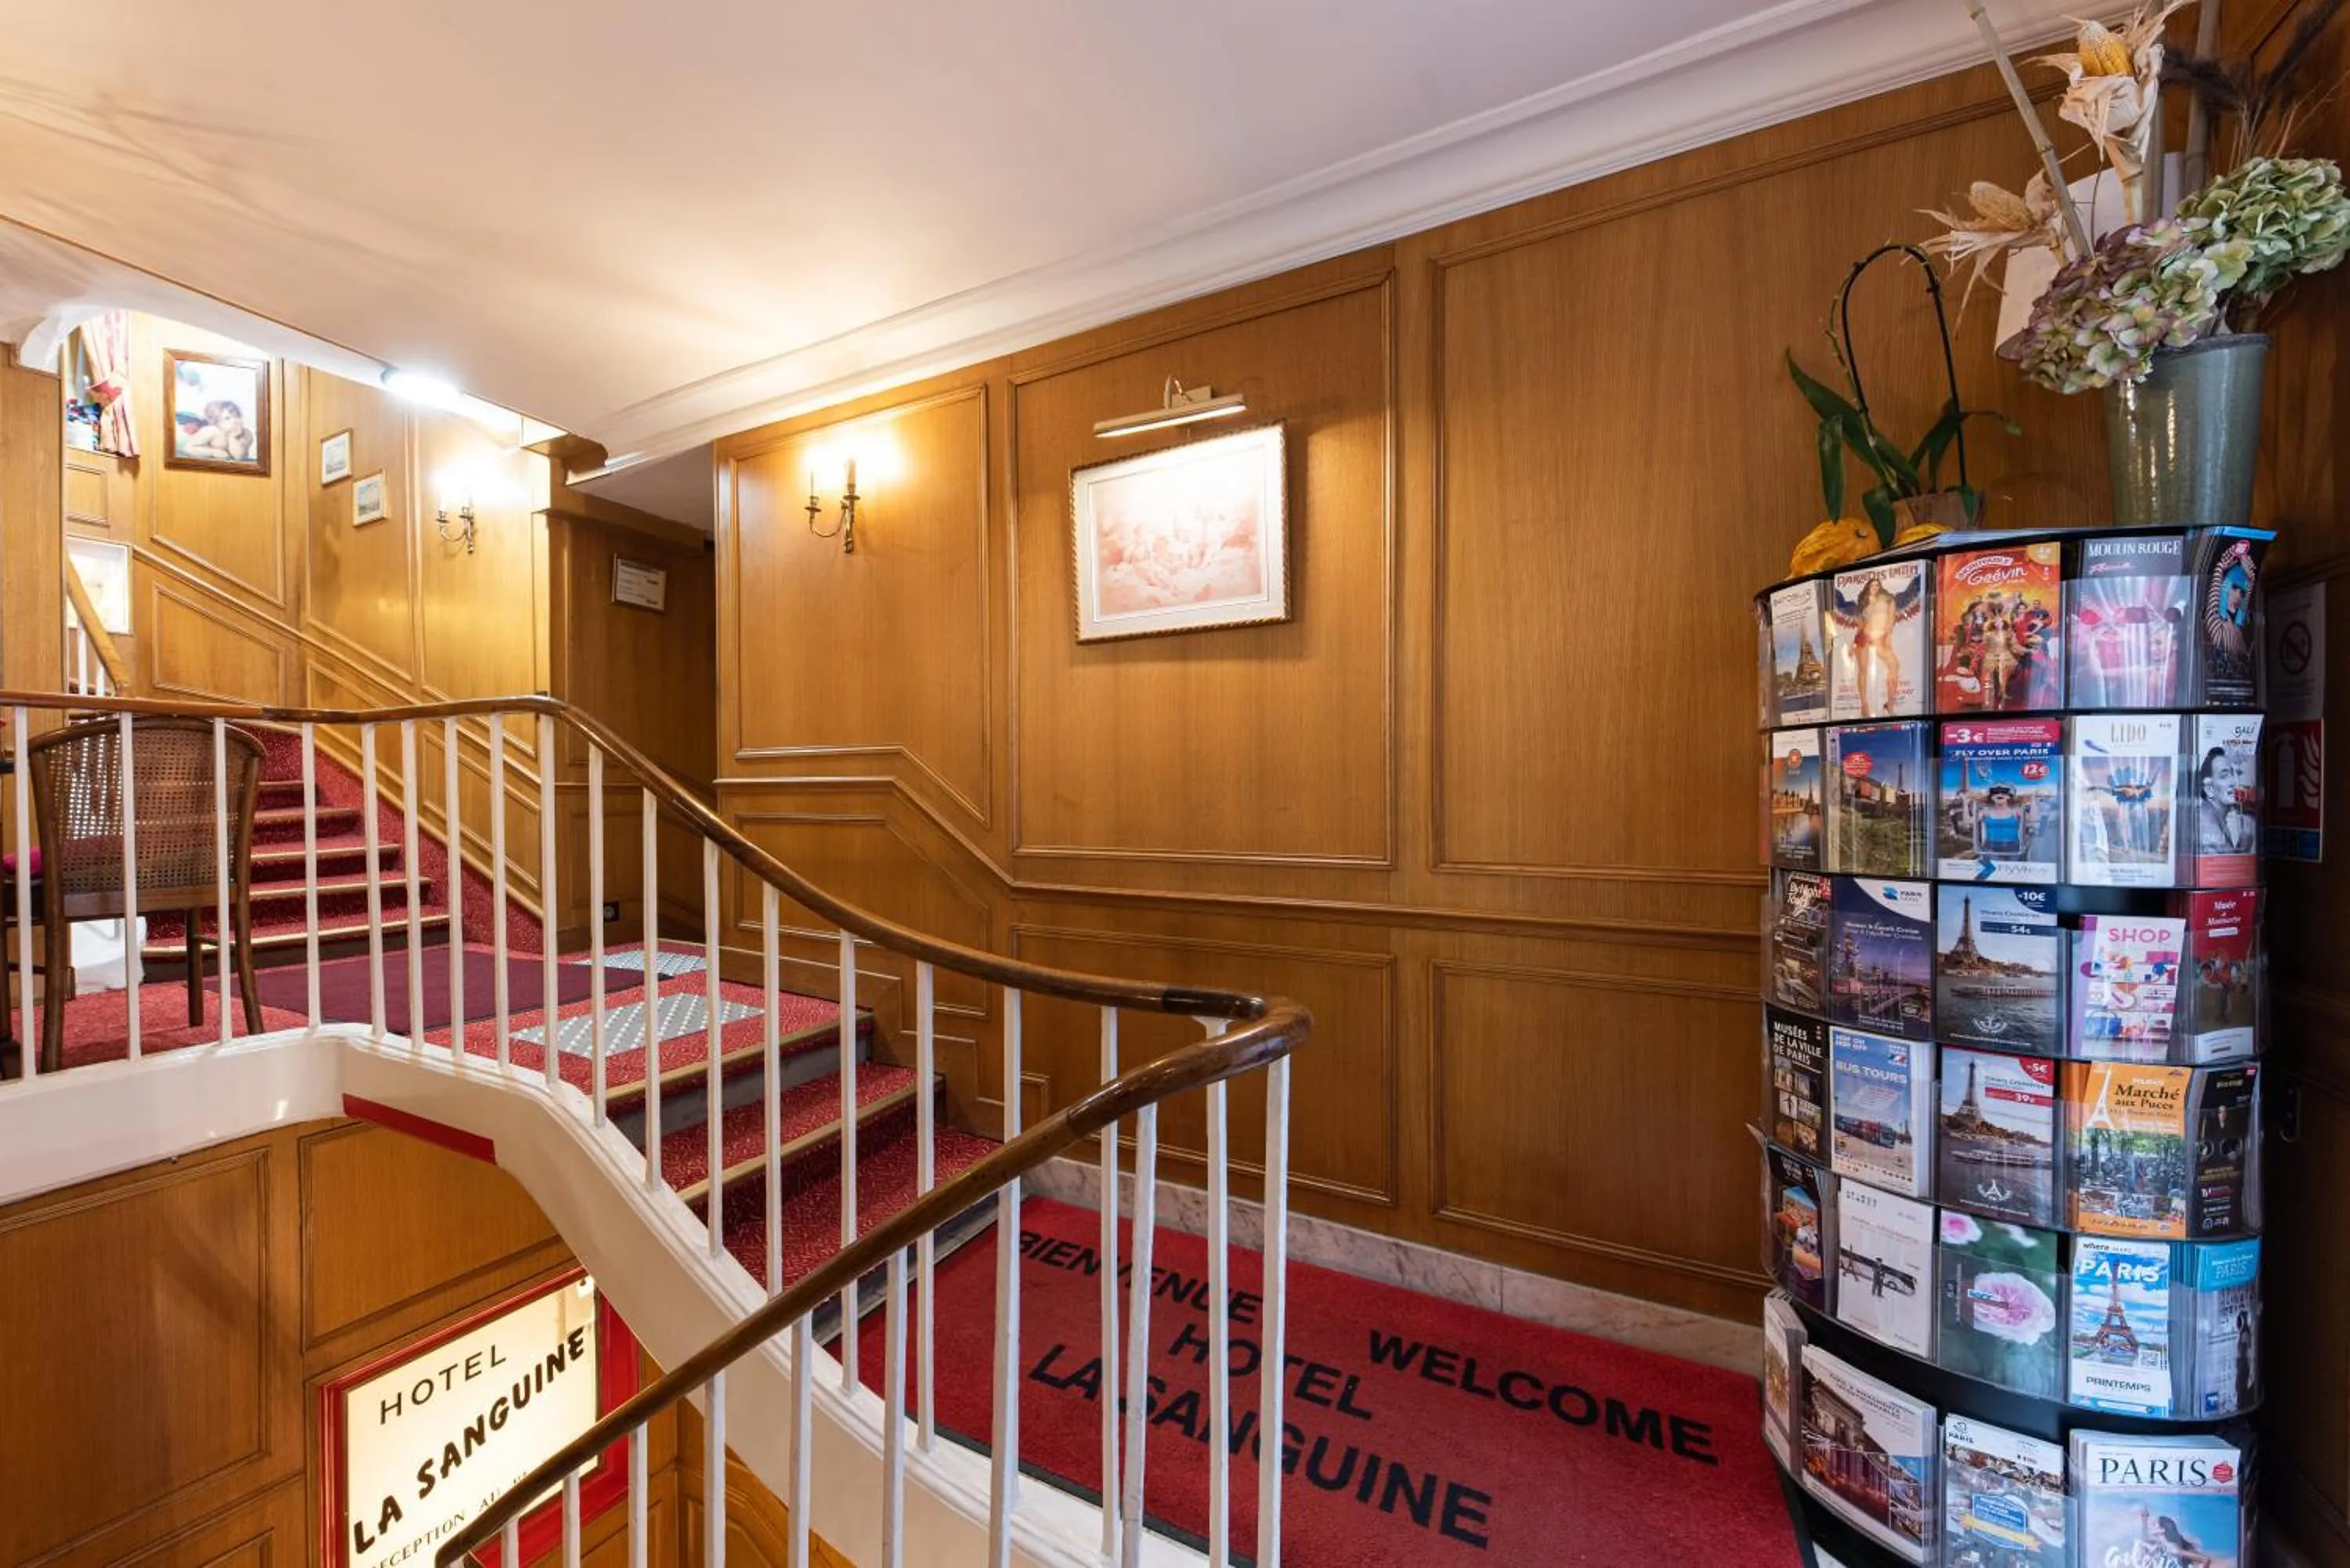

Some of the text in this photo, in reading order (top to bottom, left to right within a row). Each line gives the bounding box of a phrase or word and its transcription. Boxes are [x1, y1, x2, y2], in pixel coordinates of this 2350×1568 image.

[2088, 540, 2182, 558] MOULIN ROUGE
[2017, 891, 2046, 901] -10€
[2108, 927, 2171, 943] SHOP
[1773, 1021, 1808, 1041] MUSÉES
[1773, 1031, 1823, 1057] DE LA VILLE
[1773, 1044, 1811, 1066] DE PARIS
[1862, 1065, 1908, 1084] TOURS
[2114, 1083, 2180, 1100] Marché
[2140, 1098, 2175, 1110] Puces
[2079, 1259, 2160, 1283] PARIS
[1028, 1343, 1104, 1400] LA
[380, 1344, 507, 1425] HOTEL
[2086, 1376, 2152, 1393] PRINTEMPS
[1371, 1329, 1719, 1467] WELCOME
[353, 1327, 584, 1555] LA SANGUINE
[1948, 1432, 1975, 1444] PARIS
[2099, 1458, 2207, 1487] PARIS
[372, 1508, 466, 1568] ECEPTION
